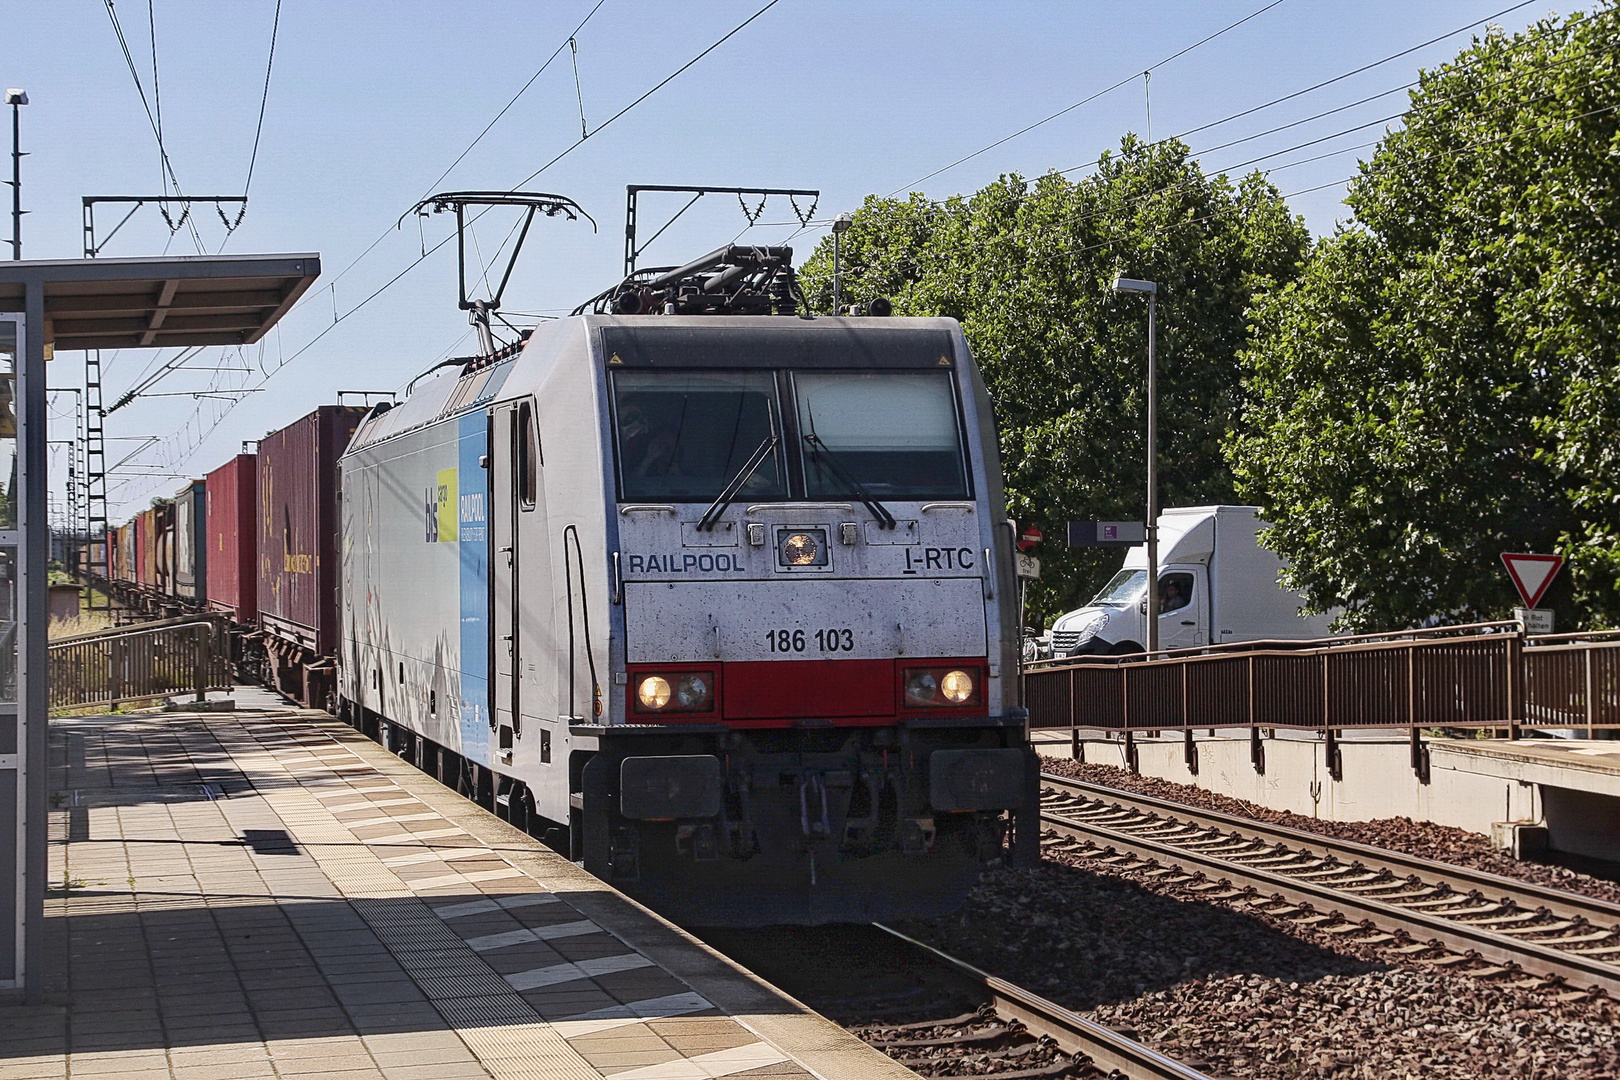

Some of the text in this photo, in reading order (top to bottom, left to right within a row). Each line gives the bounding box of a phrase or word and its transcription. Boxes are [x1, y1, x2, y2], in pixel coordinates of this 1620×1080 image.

[425, 487, 438, 543] bls
[460, 493, 485, 523] RAILPOOL
[629, 554, 745, 573] RAILPOOL
[902, 547, 975, 575] I-RTC
[765, 628, 855, 653] 186 103
